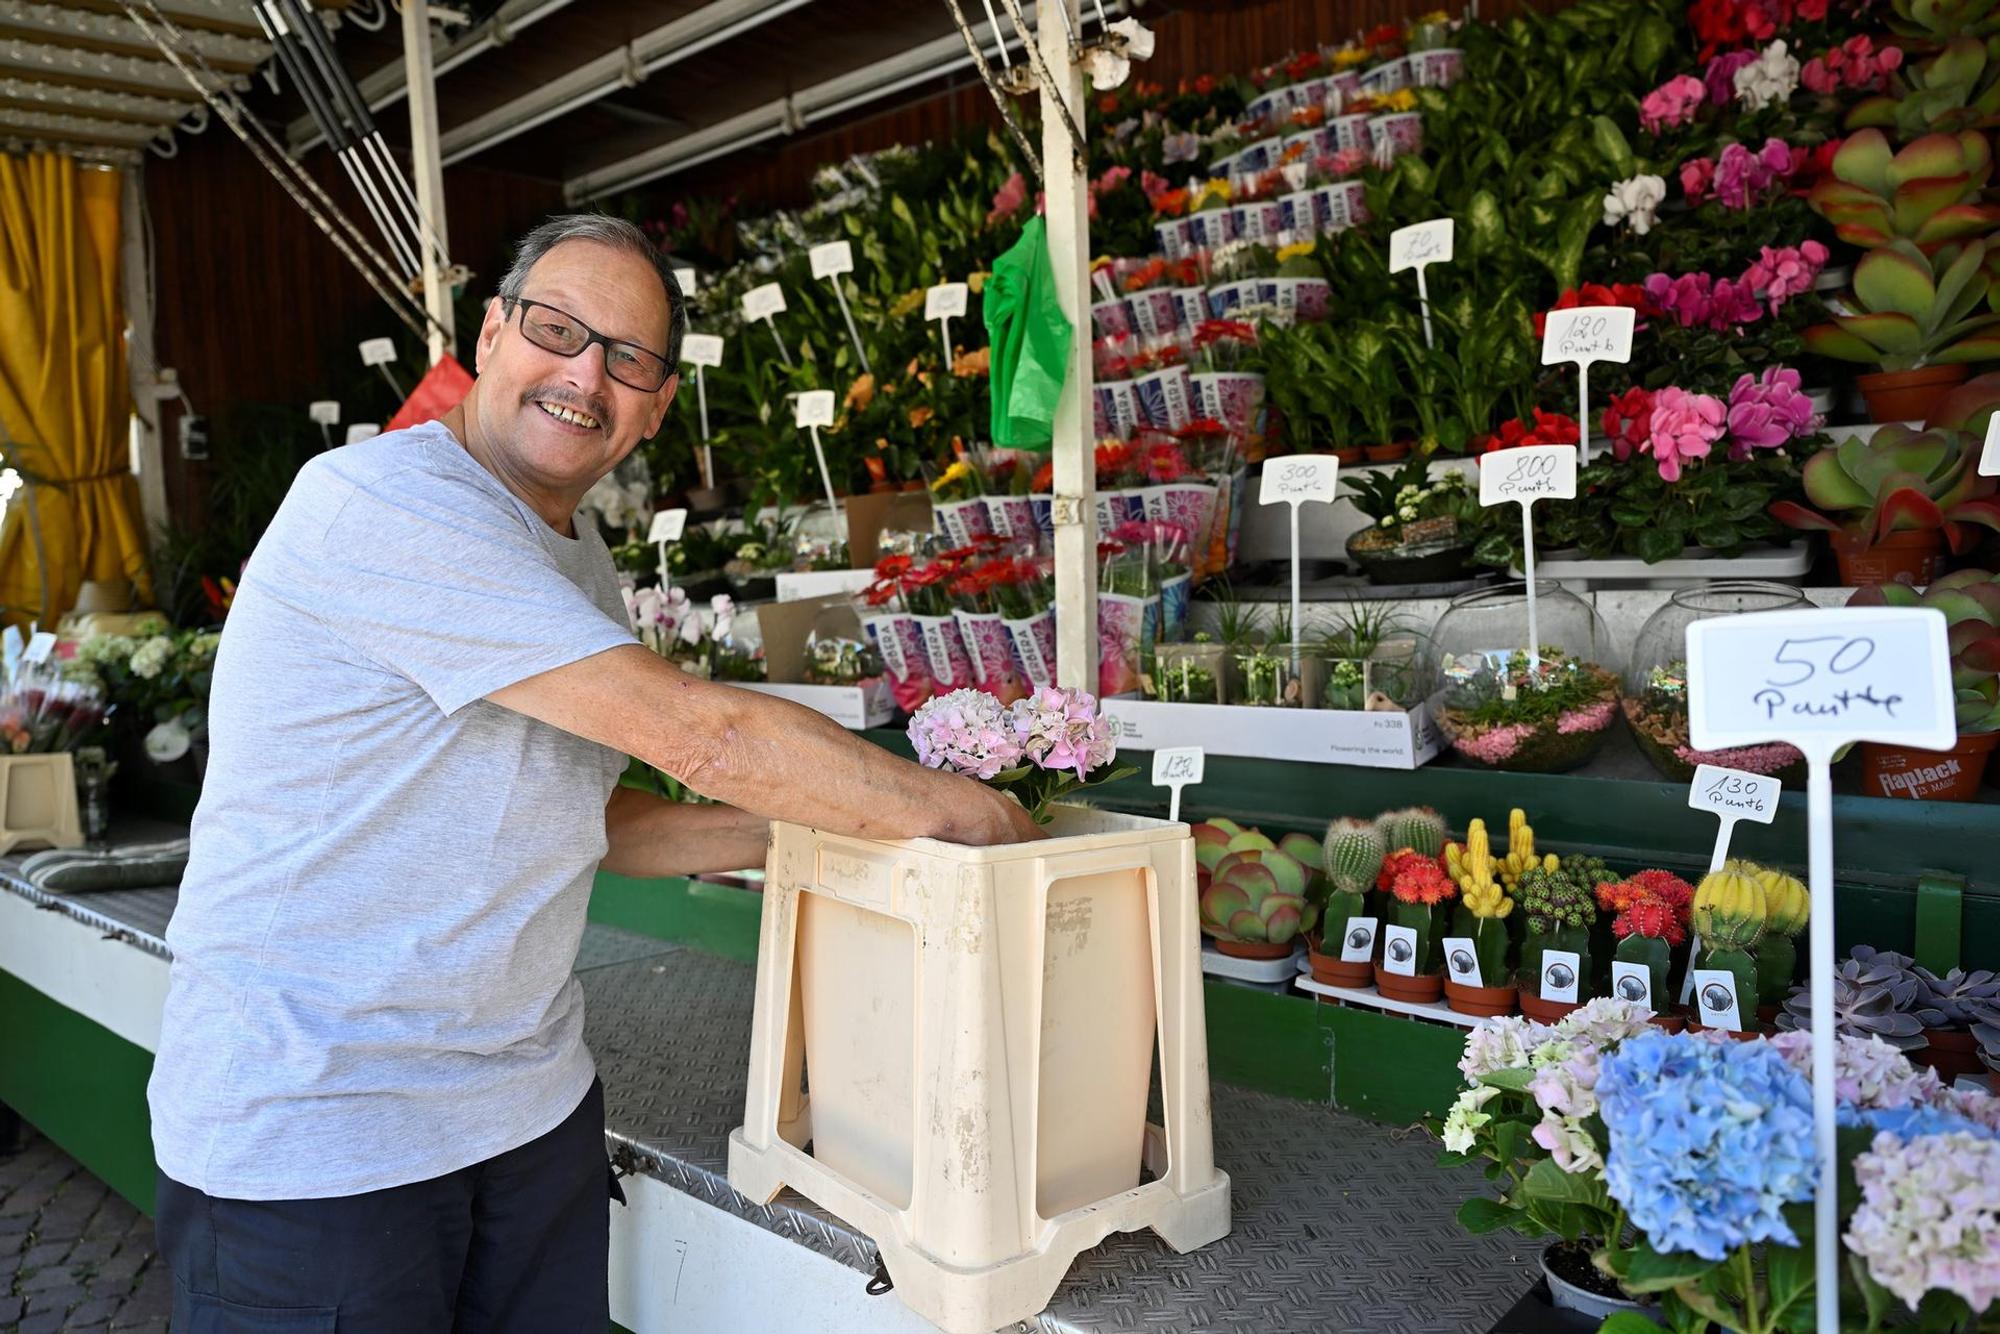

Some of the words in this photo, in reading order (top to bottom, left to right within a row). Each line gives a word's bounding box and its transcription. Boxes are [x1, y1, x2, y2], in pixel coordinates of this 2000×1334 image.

[1280, 463, 1318, 481] 300
[1506, 454, 1557, 481] 800
[926, 626, 949, 681] GERBERA
[1017, 630, 1046, 683] GERBERA
[1766, 636, 1876, 687] 50
[1705, 775, 1759, 794] 130
